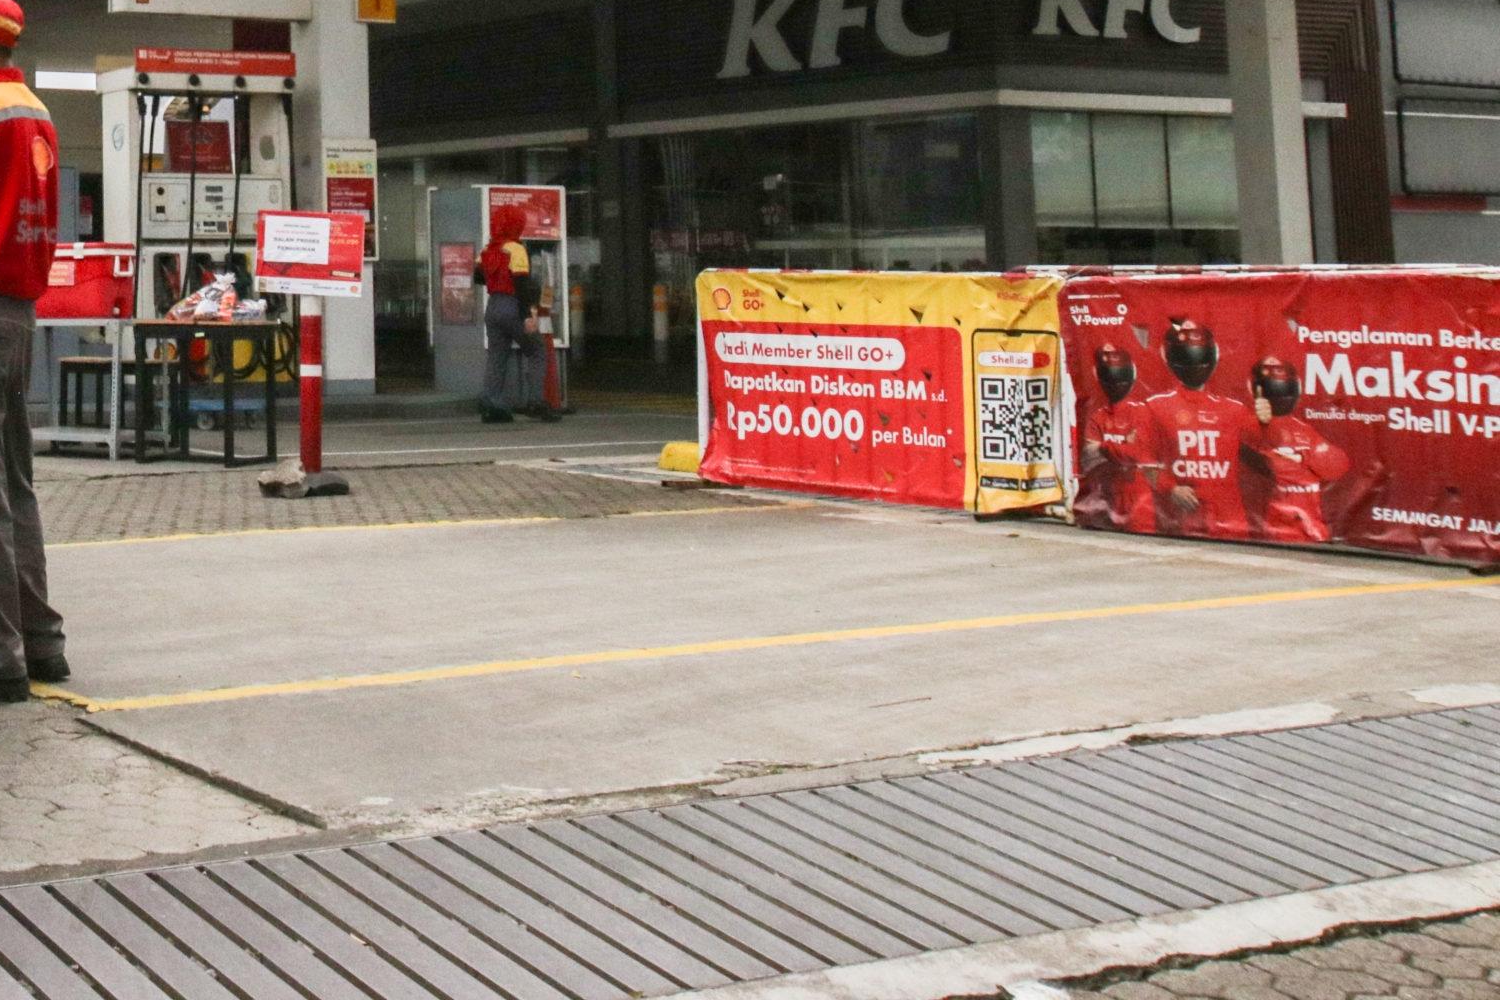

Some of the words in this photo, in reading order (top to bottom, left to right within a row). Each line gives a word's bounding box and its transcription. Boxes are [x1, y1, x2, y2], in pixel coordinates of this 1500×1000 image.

[742, 288, 760, 299] Shell
[742, 299, 765, 311] GO+
[1070, 305, 1089, 314] Shell
[1071, 314, 1125, 326] V-Power
[1298, 325, 1433, 348] Pengalaman
[752, 343, 811, 360] Member
[817, 344, 853, 361] Shell
[858, 346, 894, 363] GO+
[991, 355, 1014, 365] Shell
[724, 369, 806, 395] Dapatkan
[811, 374, 875, 398] Diskon
[880, 378, 927, 401] BBM
[726, 401, 865, 441] Rp50.000
[872, 429, 899, 448] per
[1388, 406, 1451, 434] Shell
[1177, 430, 1220, 457] PIT
[1172, 460, 1230, 479] CREW
[1372, 507, 1464, 530] SEMANGAT
